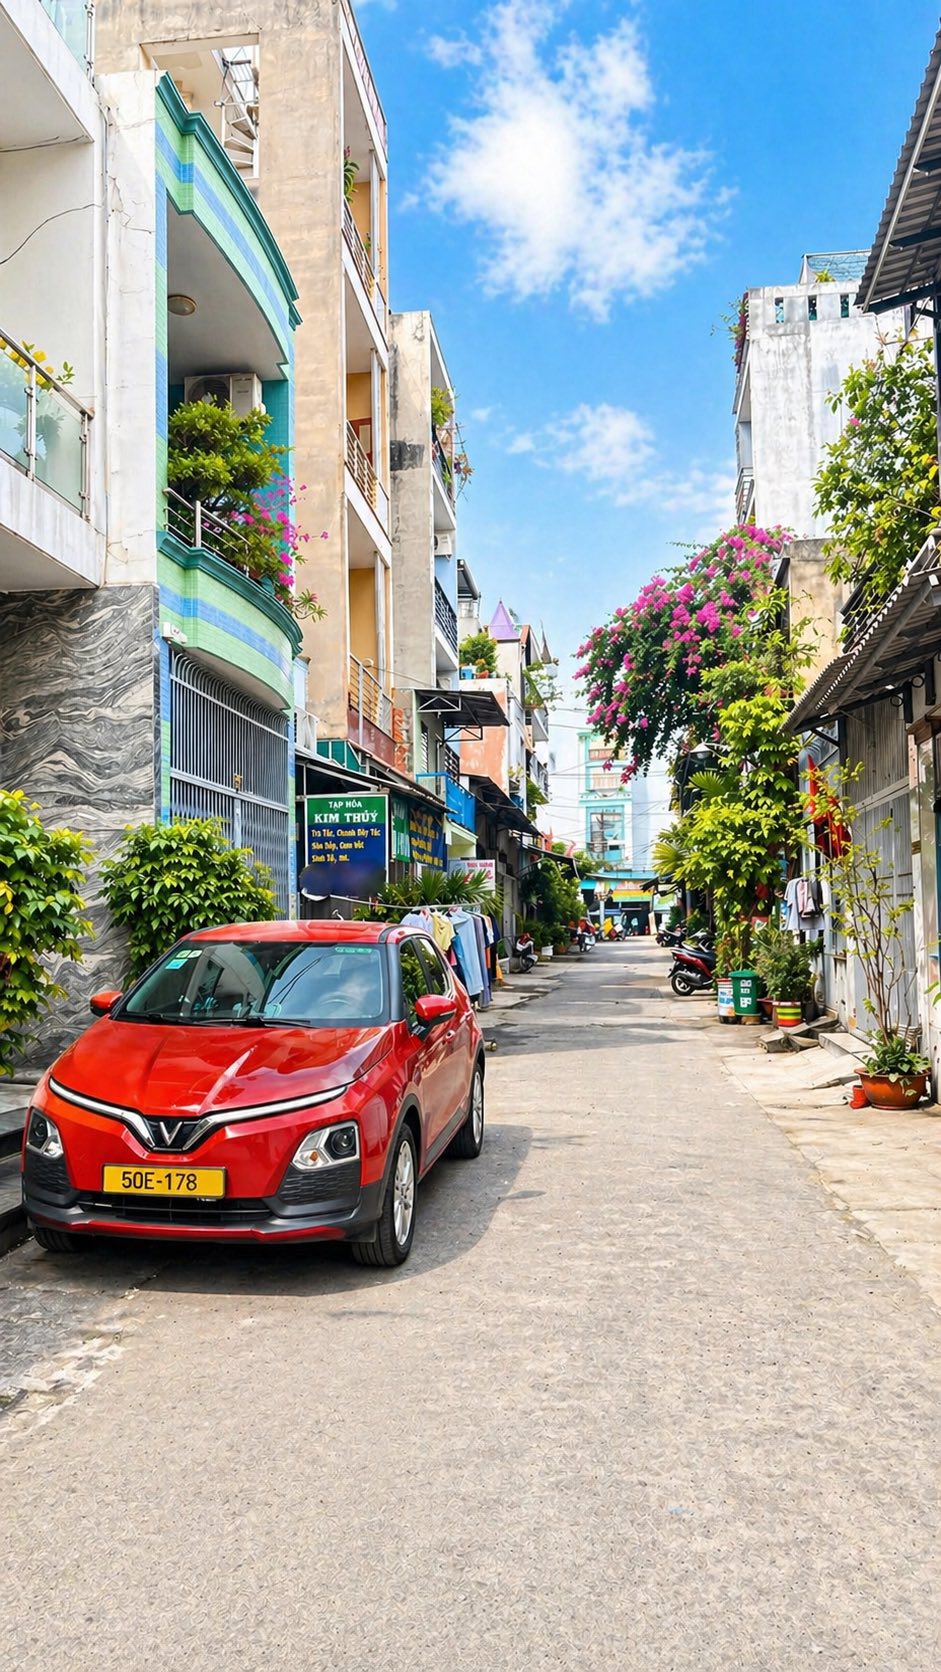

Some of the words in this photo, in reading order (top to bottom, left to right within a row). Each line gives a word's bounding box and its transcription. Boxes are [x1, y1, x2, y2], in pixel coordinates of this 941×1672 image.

[328, 800, 343, 811] TẠP
[314, 813, 340, 823] KIM
[122, 1171, 197, 1191] 50E-178
